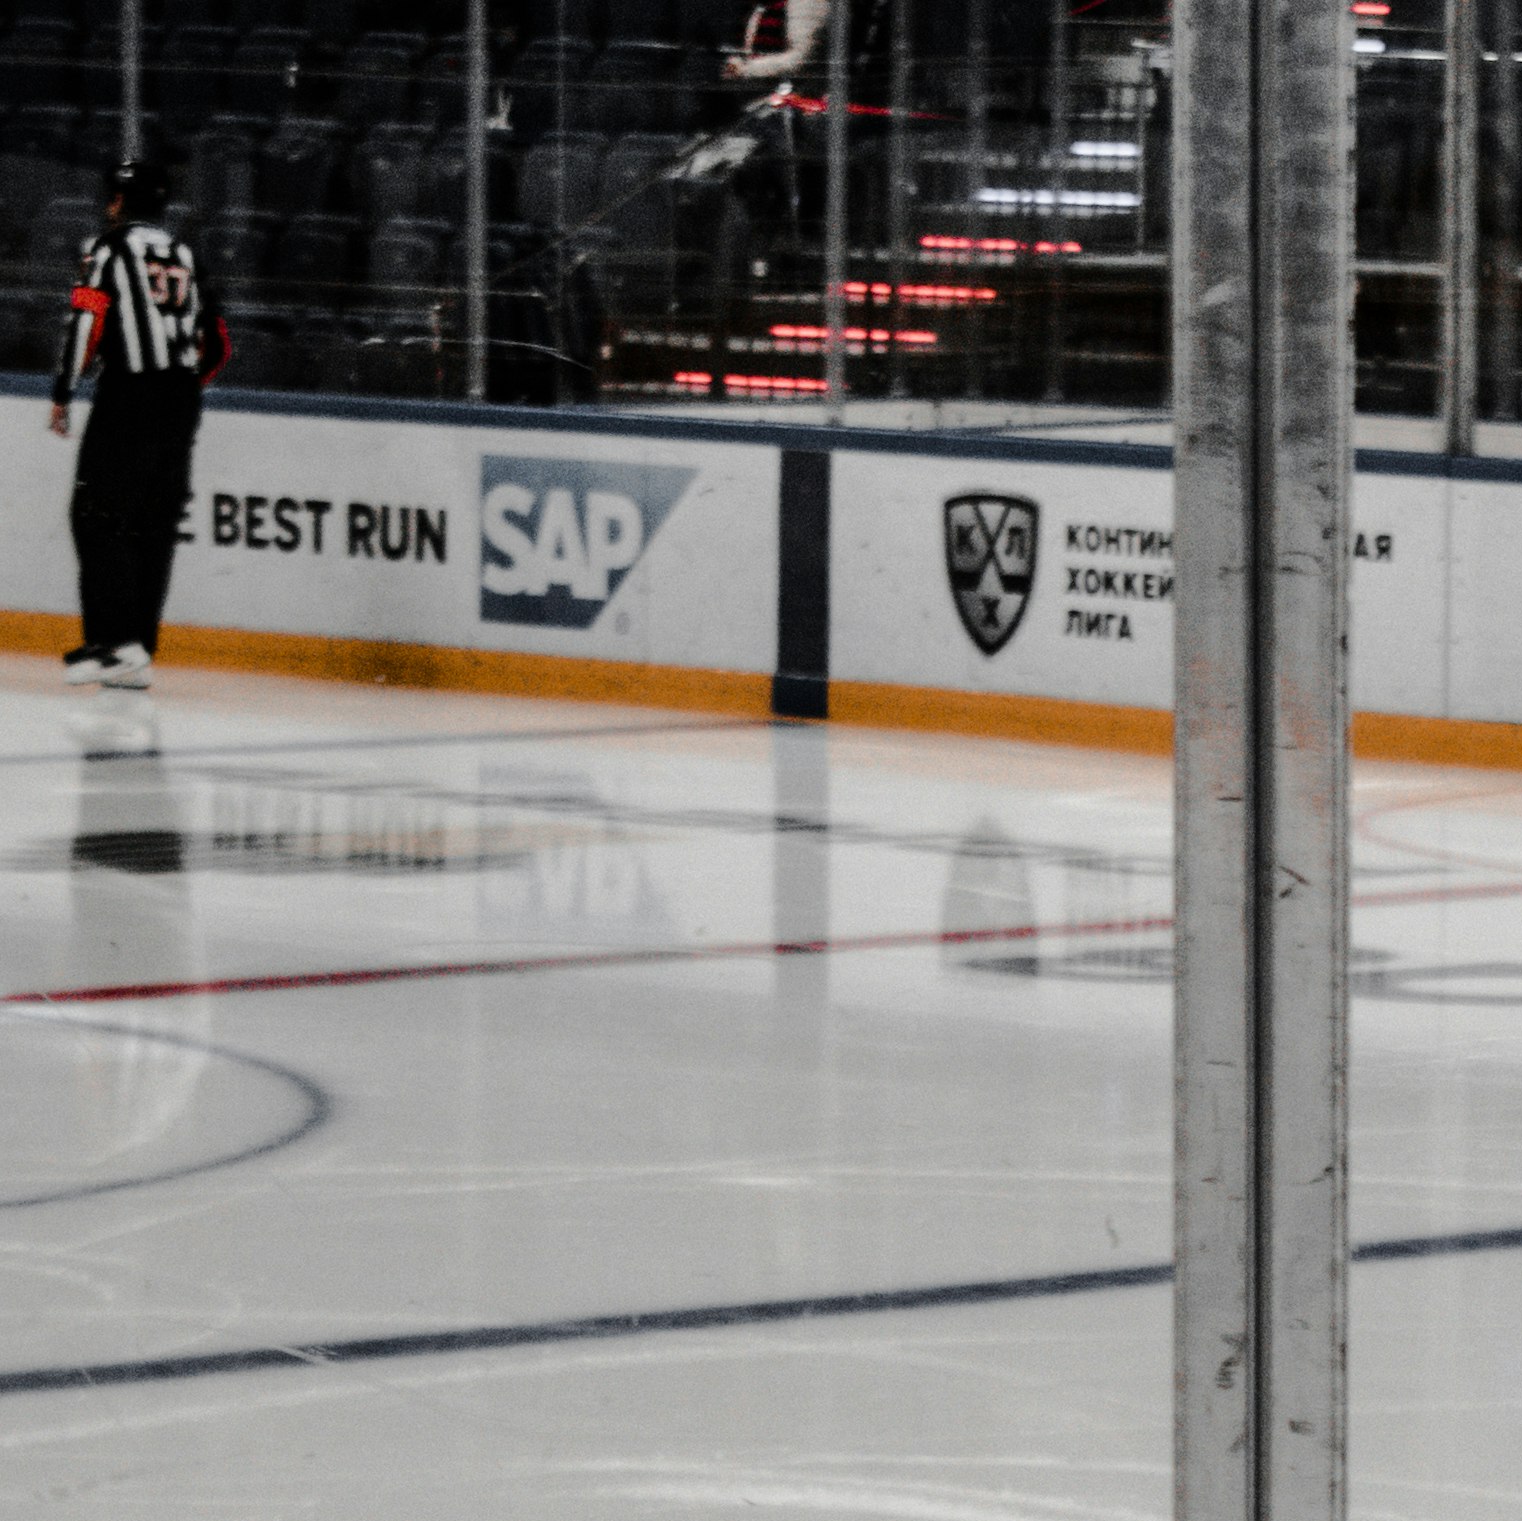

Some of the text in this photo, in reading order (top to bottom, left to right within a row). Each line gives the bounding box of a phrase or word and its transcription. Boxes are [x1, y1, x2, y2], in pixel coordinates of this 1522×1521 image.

[212, 493, 332, 555] BEST
[347, 503, 448, 564] RUN
[482, 483, 645, 602] SAP
[1065, 610, 1134, 641] ЛИГА
